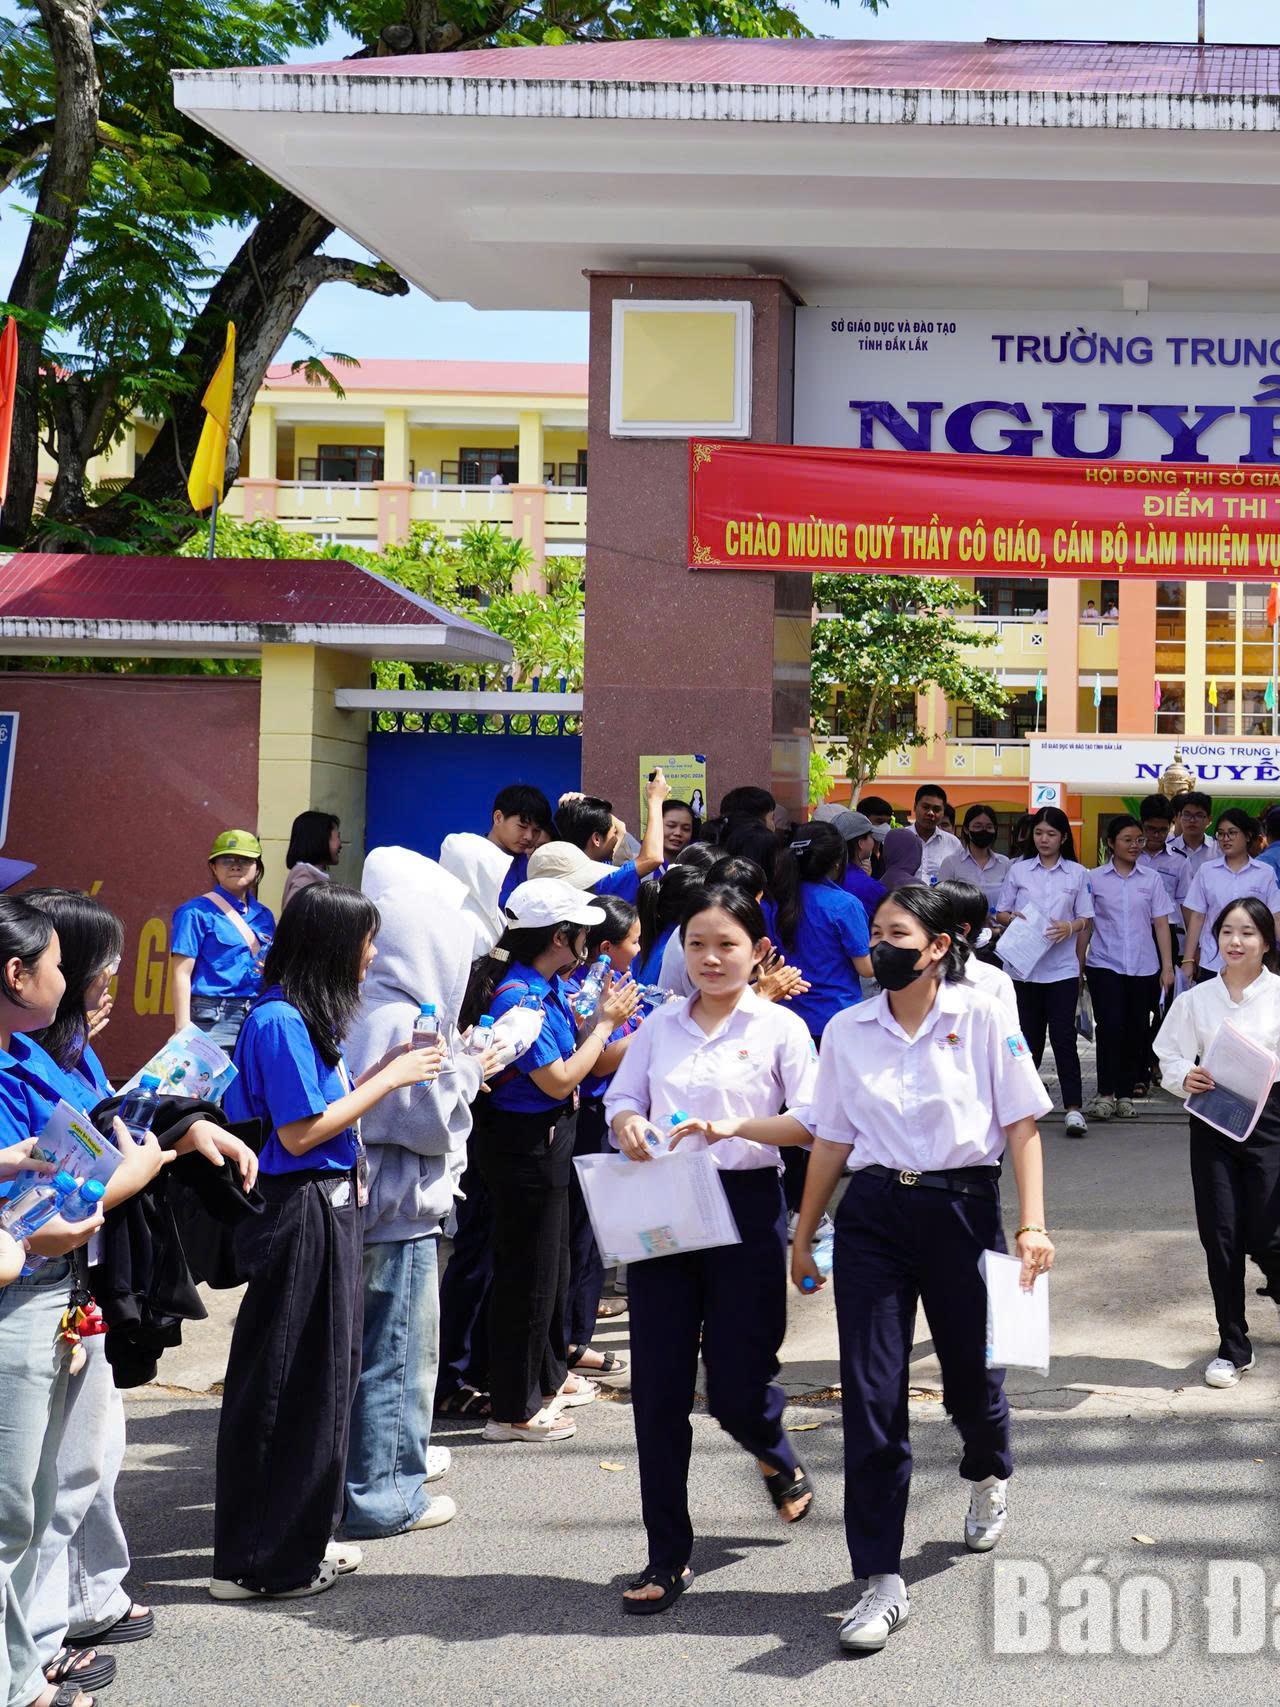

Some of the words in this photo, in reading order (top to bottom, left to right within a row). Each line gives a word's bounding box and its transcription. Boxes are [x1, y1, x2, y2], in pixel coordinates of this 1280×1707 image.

[831, 318, 845, 332] SỞ
[847, 319, 871, 333] GIÁO
[874, 321, 895, 335] DỤC
[898, 319, 911, 333] VÀ
[913, 320, 934, 333] ĐÀO
[936, 322, 957, 336] TẠO
[858, 336, 882, 351] TỈNH
[885, 336, 906, 351] ĐẮK
[909, 336, 929, 351] LẮK
[992, 327, 1153, 364] TRƯỜNG
[1085, 467, 1117, 485] HỘI
[1183, 471, 1213, 485] THI
[1143, 488, 1214, 518] ĐIỂM
[1222, 497, 1266, 519] THI
[725, 513, 780, 557] CHÀO
[788, 514, 848, 559] MỪNG
[854, 517, 896, 563] QUÝ
[901, 513, 953, 561] THẦY
[959, 519, 987, 562] CÔ
[993, 520, 1046, 568] GIÁO,
[1053, 521, 1093, 564] CÁN
[1101, 522, 1128, 572] BỘ
[1135, 522, 1177, 565] LÀM
[1184, 524, 1249, 574] NHIỆM
[1178, 744, 1226, 756] RƯỜNG
[1231, 747, 1271, 757] TRUNG
